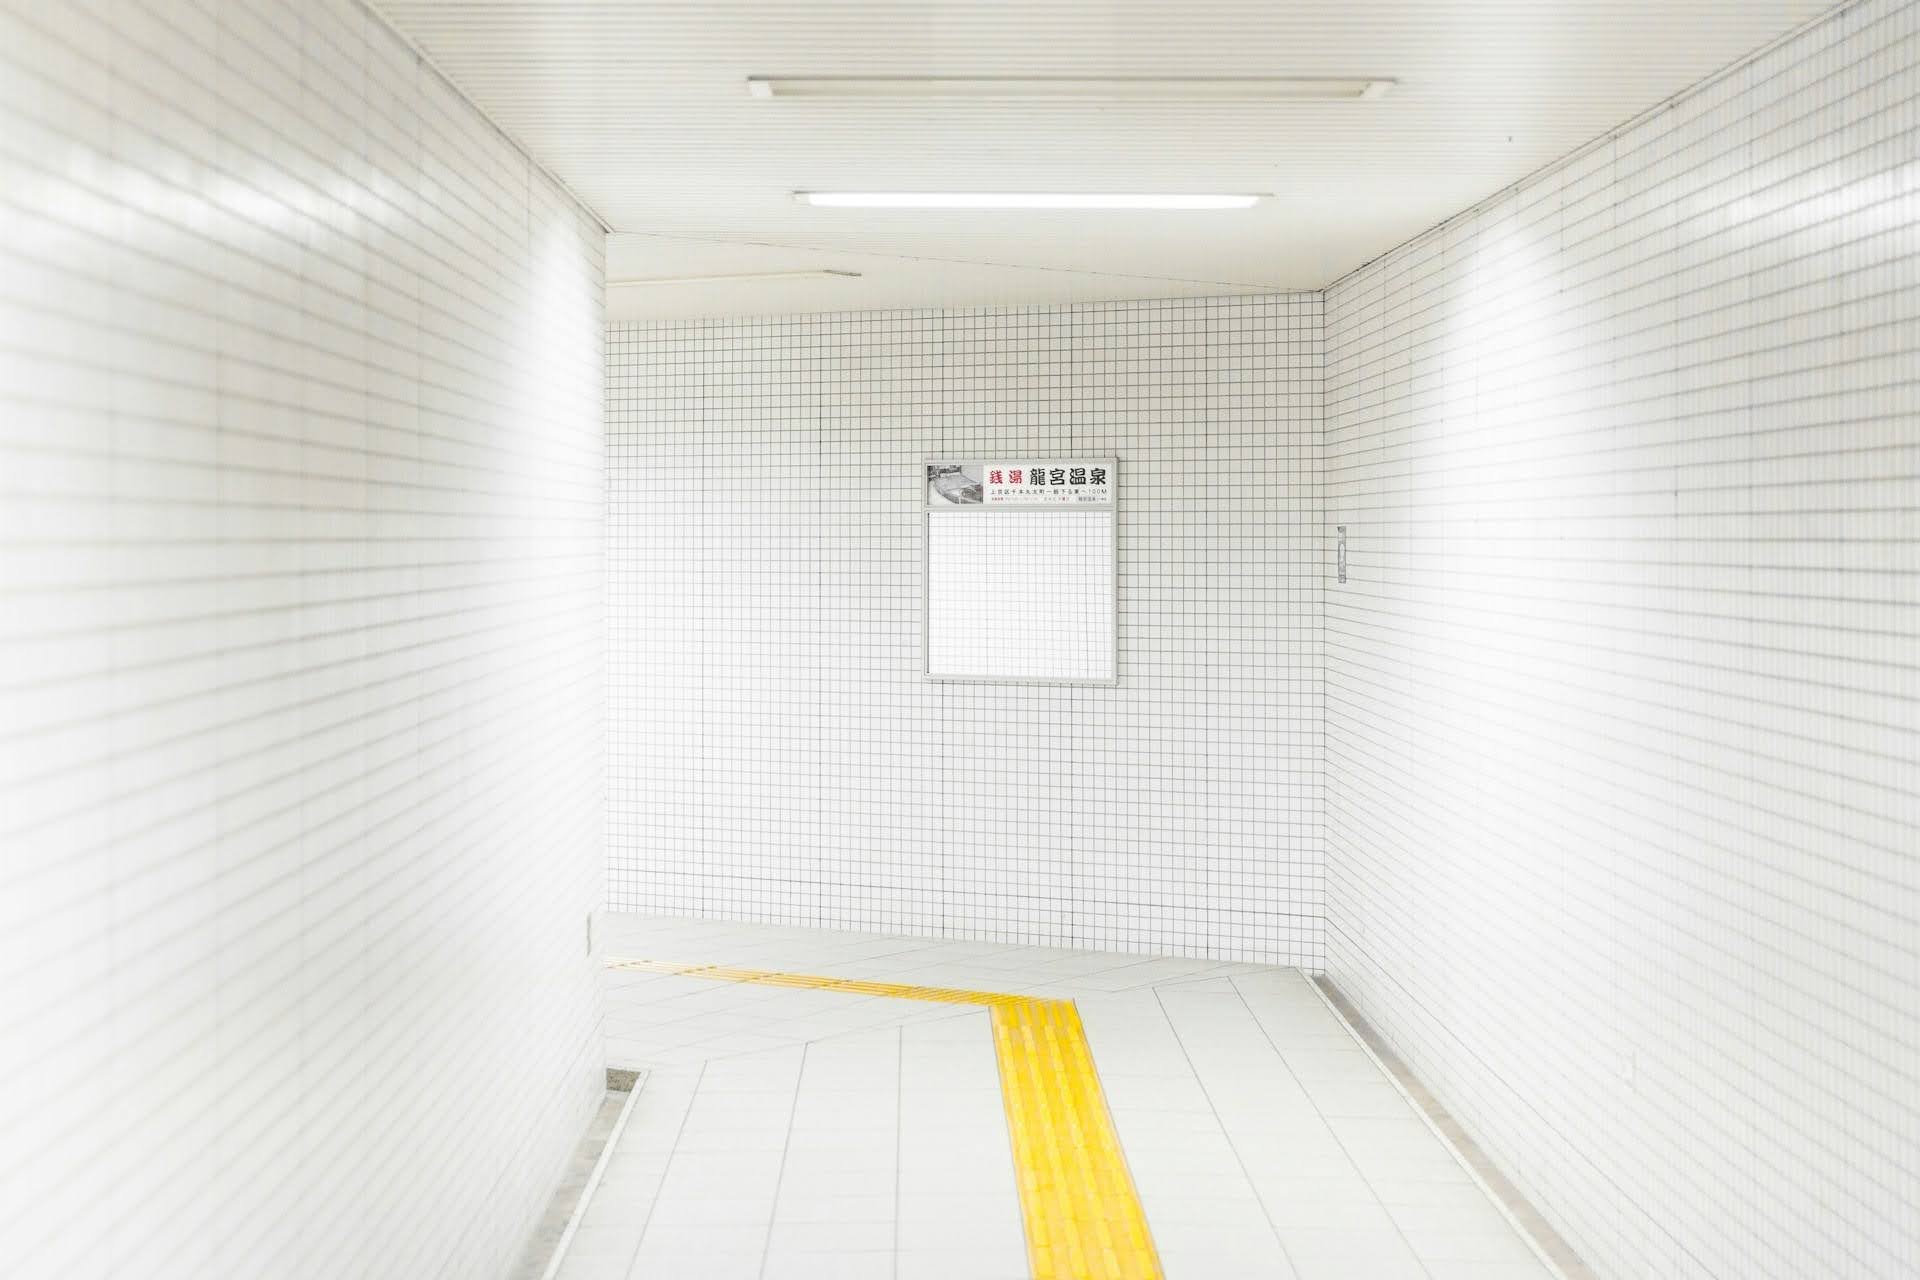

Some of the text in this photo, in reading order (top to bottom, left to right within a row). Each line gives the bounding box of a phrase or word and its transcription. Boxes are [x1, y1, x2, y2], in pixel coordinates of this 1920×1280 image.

[990, 468, 1106, 486] 銭湯 龍宮温泉
